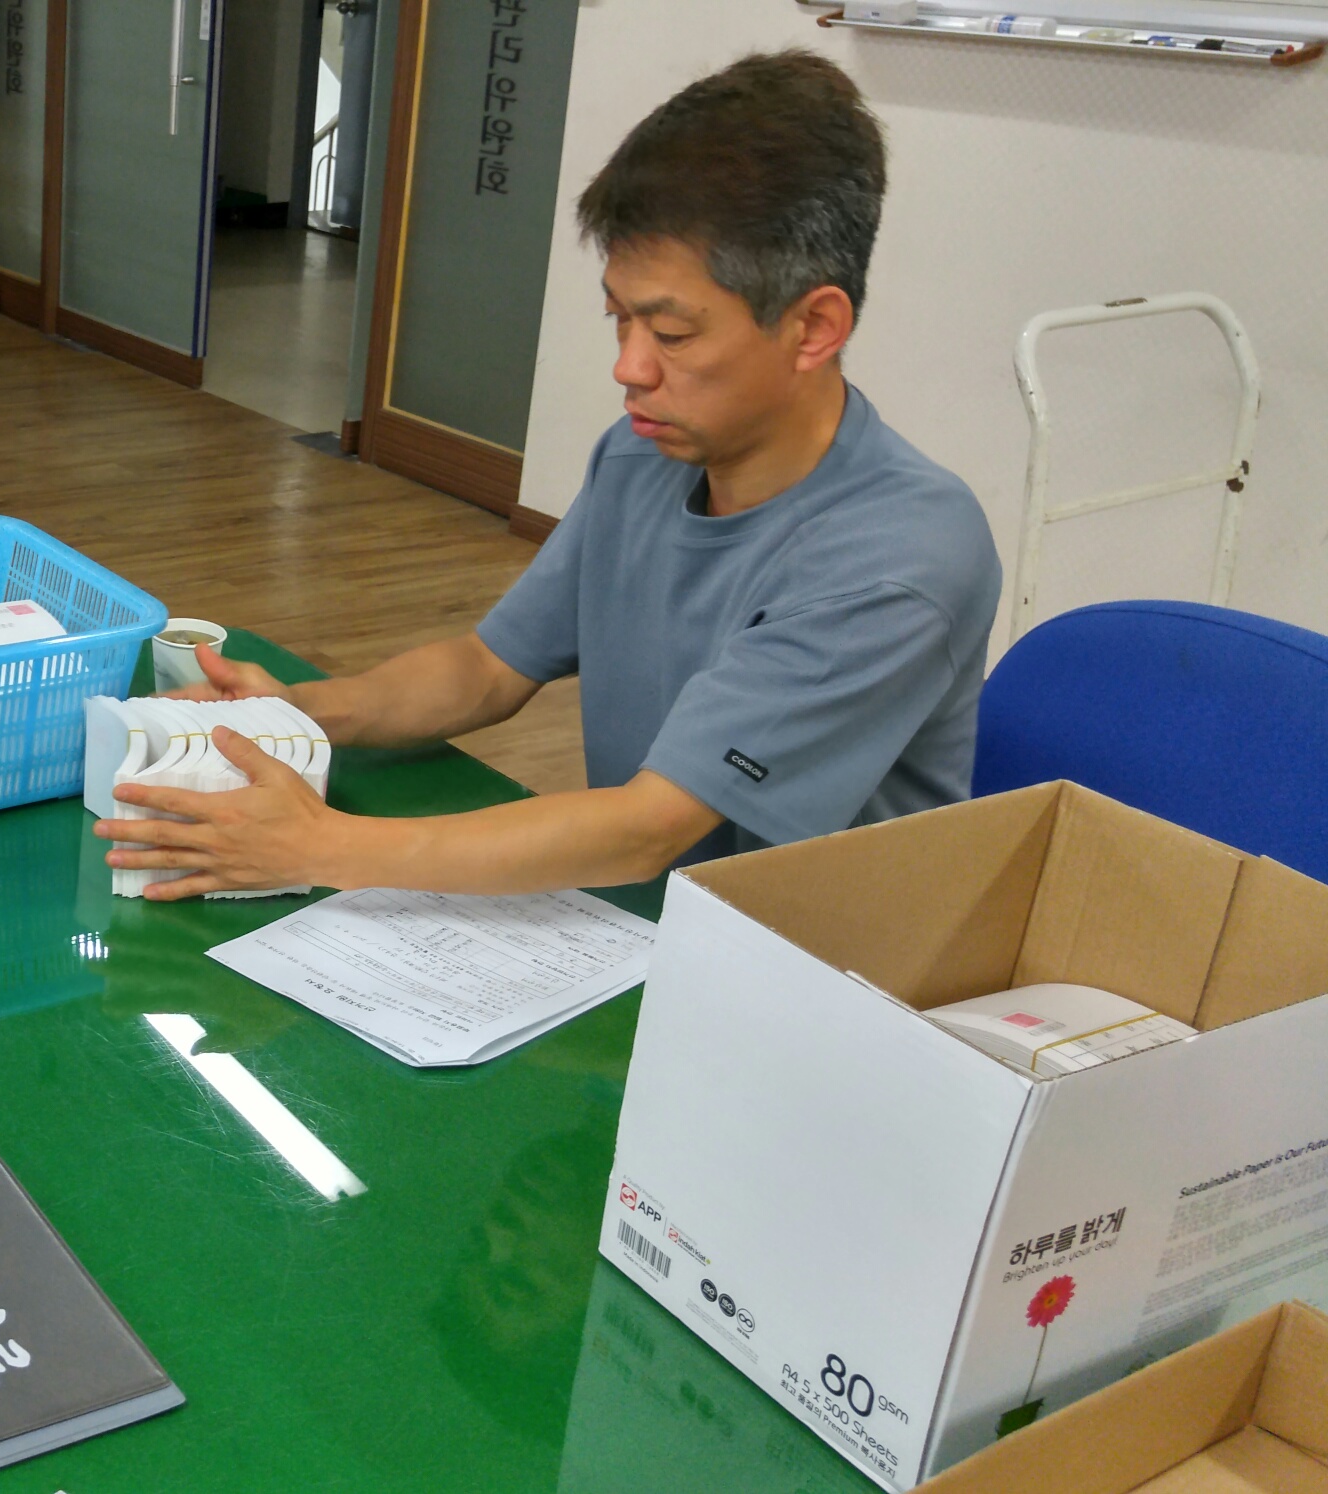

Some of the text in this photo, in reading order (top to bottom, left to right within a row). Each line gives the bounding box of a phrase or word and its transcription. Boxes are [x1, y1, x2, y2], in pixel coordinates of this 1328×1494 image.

[732, 755, 763, 778] COOLON
[1243, 1159, 1273, 1176] Paper
[637, 1201, 662, 1222] APP
[1009, 1206, 1126, 1265] 하루를 밝게
[1003, 1261, 1049, 1283] Brighten
[820, 1353, 909, 1424] 80 gsm
[780, 1379, 896, 1479] 최고 품질의 Premium 복사용지
[782, 1363, 799, 1384] A4
[802, 1379, 811, 1394] 5
[823, 1396, 849, 1425] 500
[852, 1420, 898, 1466] Sheets
